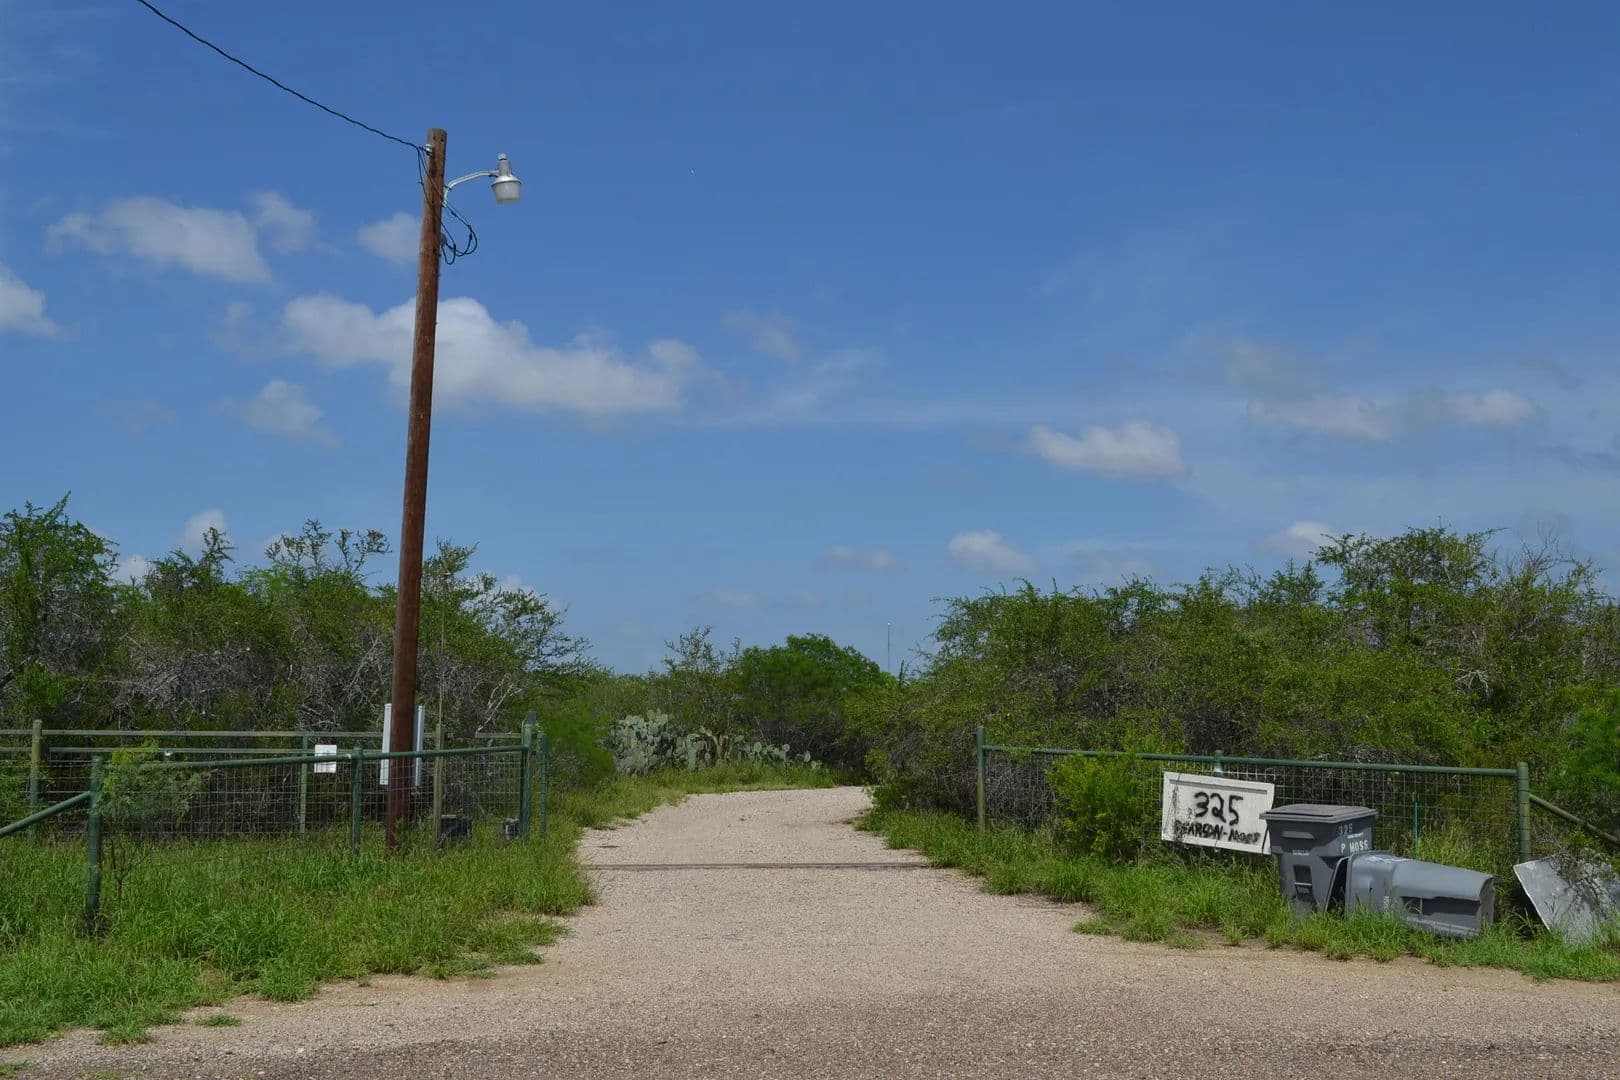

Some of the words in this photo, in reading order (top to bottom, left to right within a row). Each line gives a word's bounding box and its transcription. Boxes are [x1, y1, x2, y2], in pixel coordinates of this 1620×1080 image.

[1194, 791, 1243, 826] 325
[1341, 843, 1346, 854] P
[1349, 839, 1369, 853] MOSS
